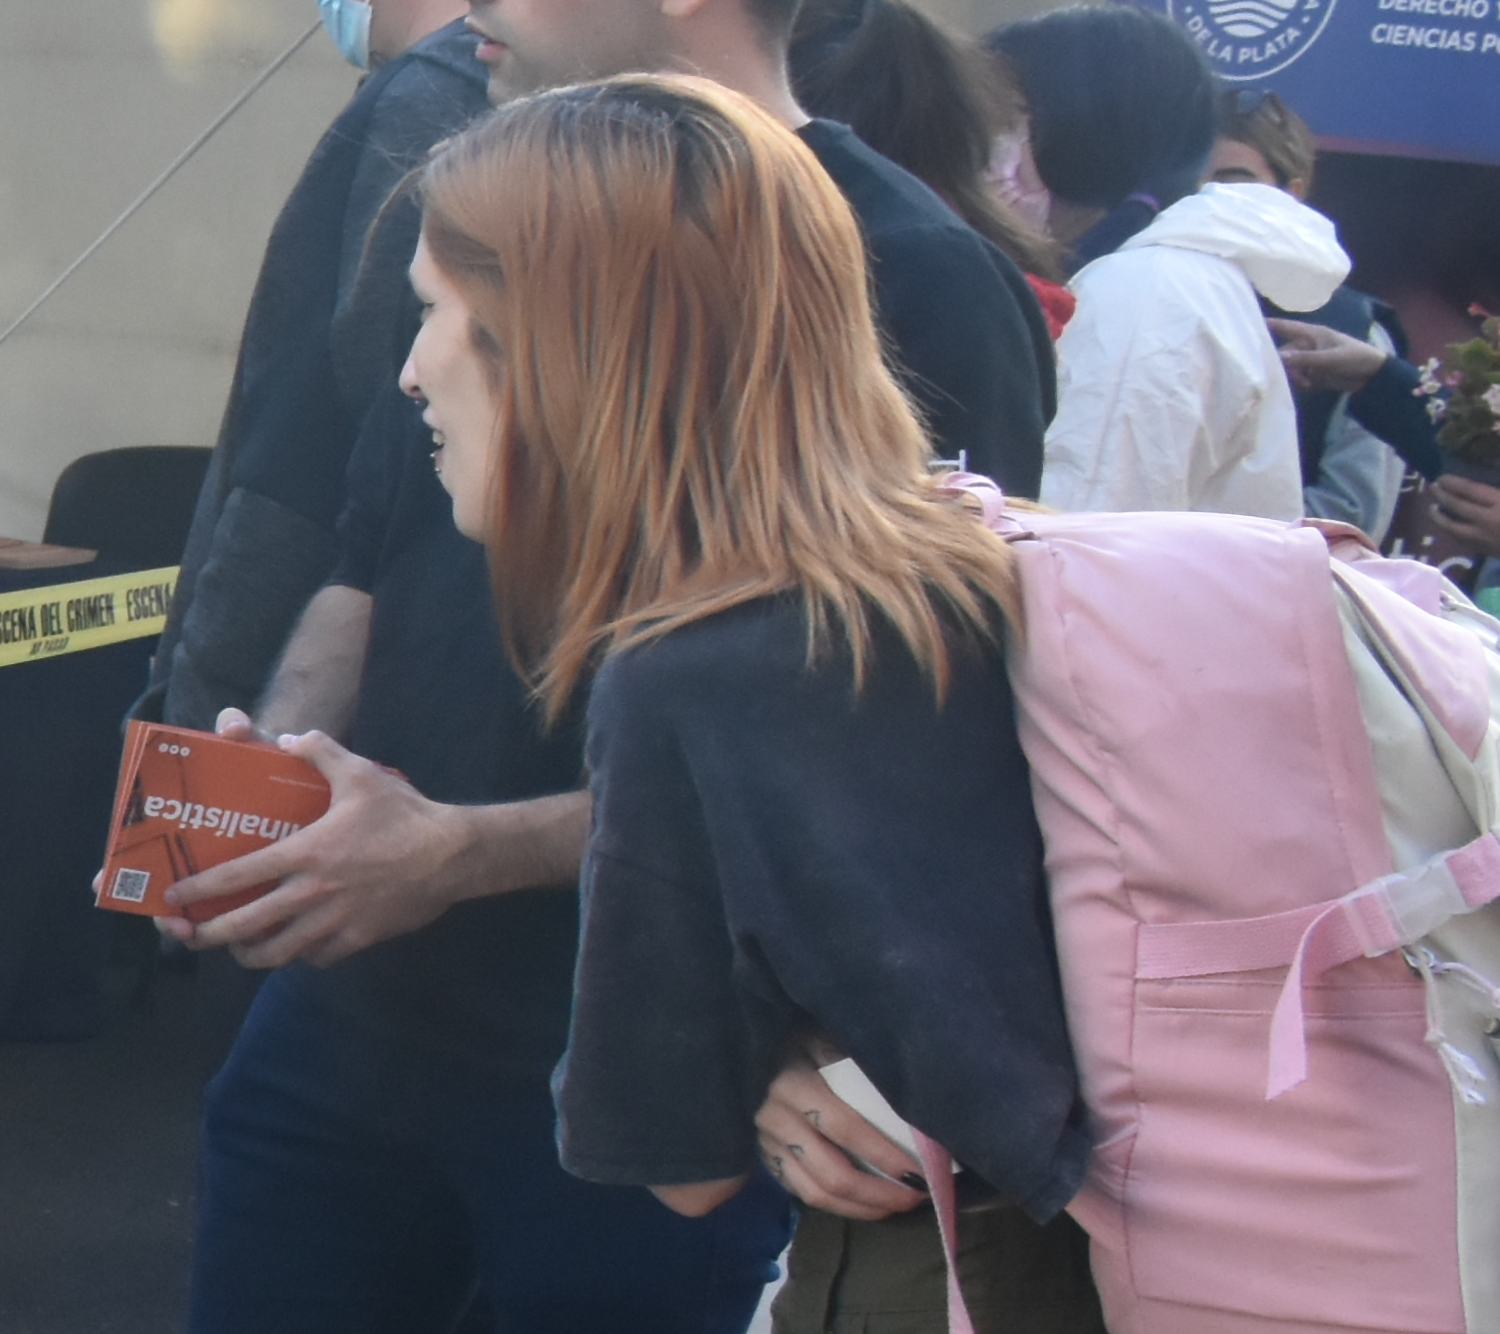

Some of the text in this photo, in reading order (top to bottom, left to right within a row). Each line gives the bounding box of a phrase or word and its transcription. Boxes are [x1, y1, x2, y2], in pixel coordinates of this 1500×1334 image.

[1186, 15, 1300, 64] DE LA PLATA
[1371, 22, 1477, 52] CIENCIAS
[40, 601, 63, 637] DEL
[67, 592, 115, 632] CRIMEN
[143, 794, 303, 842] inalística
